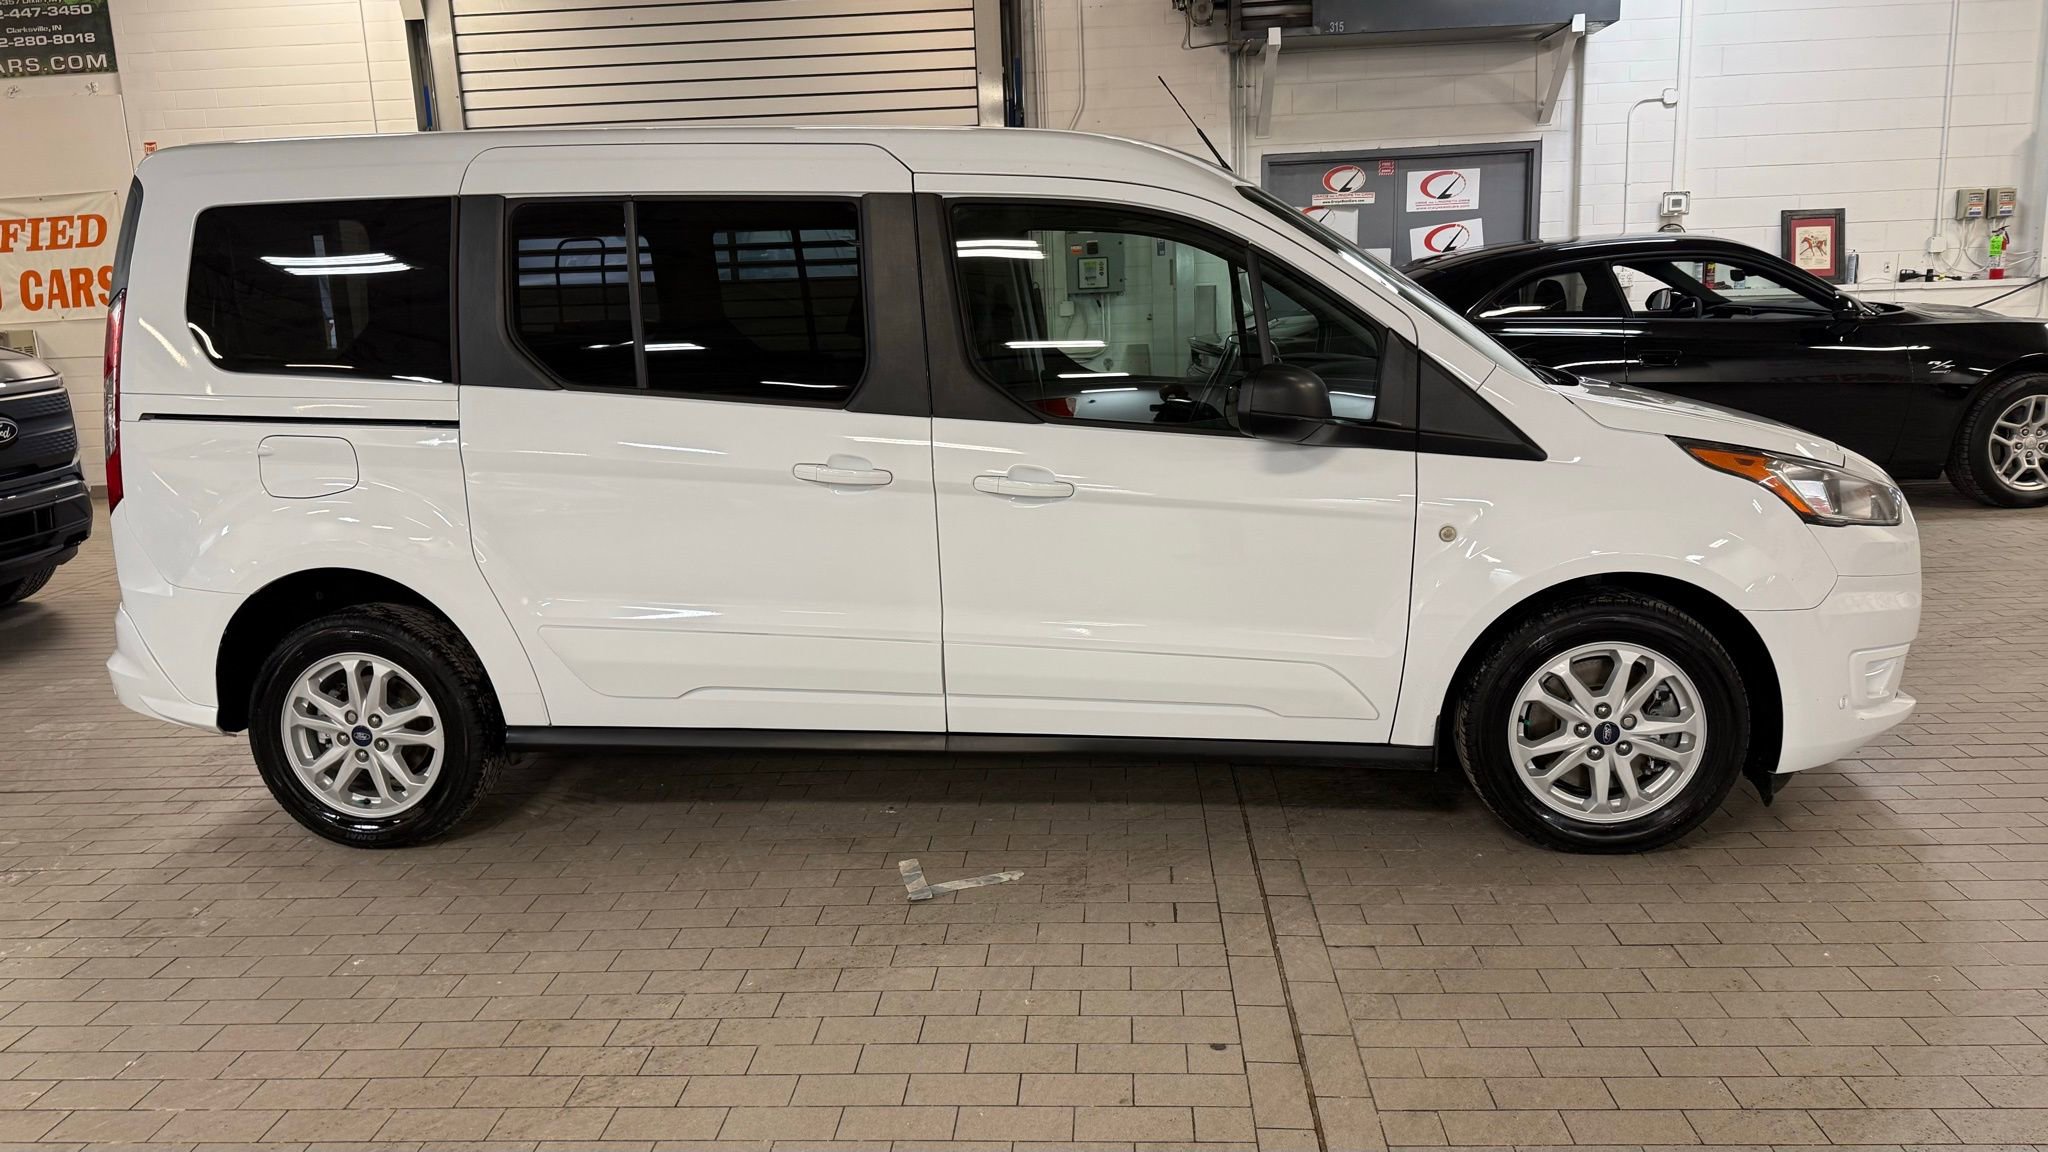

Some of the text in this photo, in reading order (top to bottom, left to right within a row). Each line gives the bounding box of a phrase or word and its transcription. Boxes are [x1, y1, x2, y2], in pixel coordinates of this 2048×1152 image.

[6, 26, 51, 34] Clarksville,
[1330, 21, 1344, 32] 315
[0, 214, 108, 253] FIED
[20, 265, 113, 311] CARS
